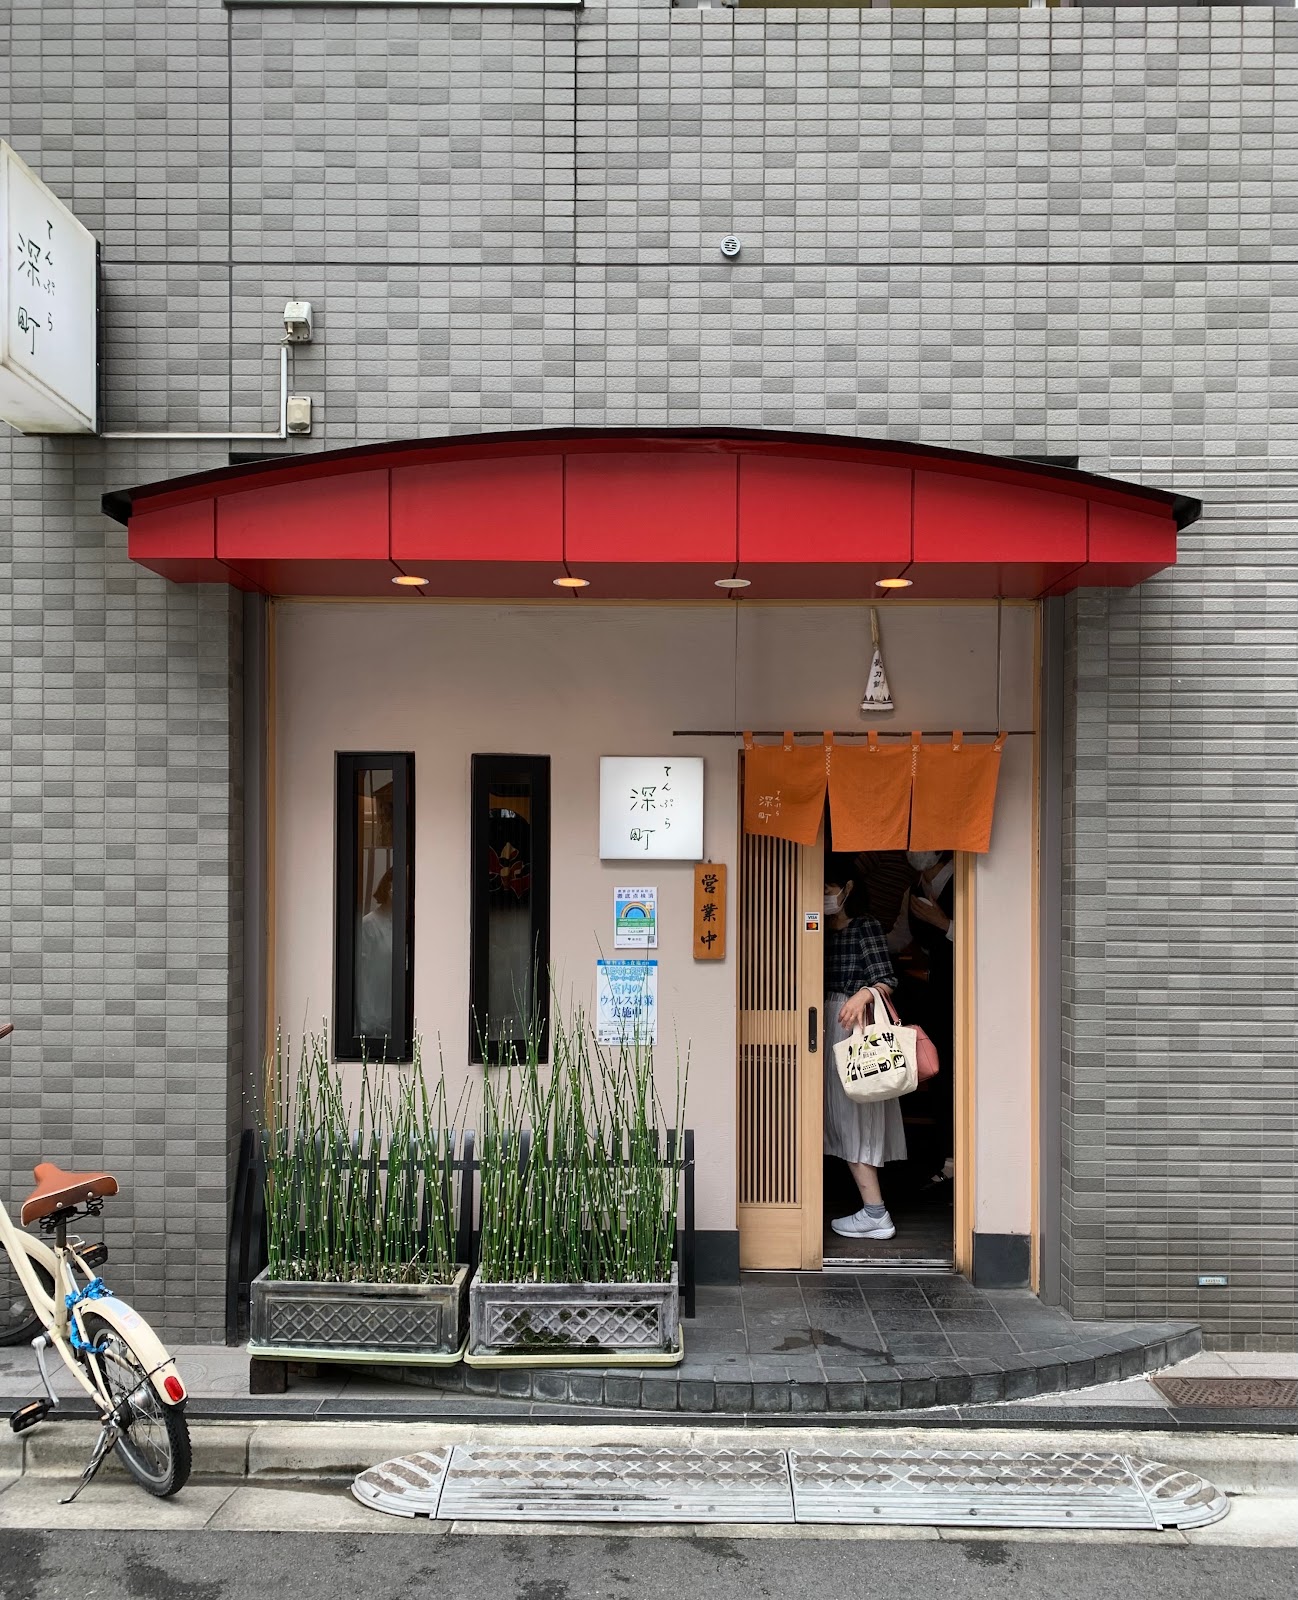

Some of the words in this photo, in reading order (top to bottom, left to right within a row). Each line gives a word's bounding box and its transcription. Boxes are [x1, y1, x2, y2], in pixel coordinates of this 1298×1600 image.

[17, 232, 41, 356] 深町
[629, 786, 657, 851] 深町
[659, 765, 675, 830] てんぷら
[758, 795, 774, 824] 深町
[700, 873, 719, 950] 営業中
[611, 1006, 642, 1018] 実施中
